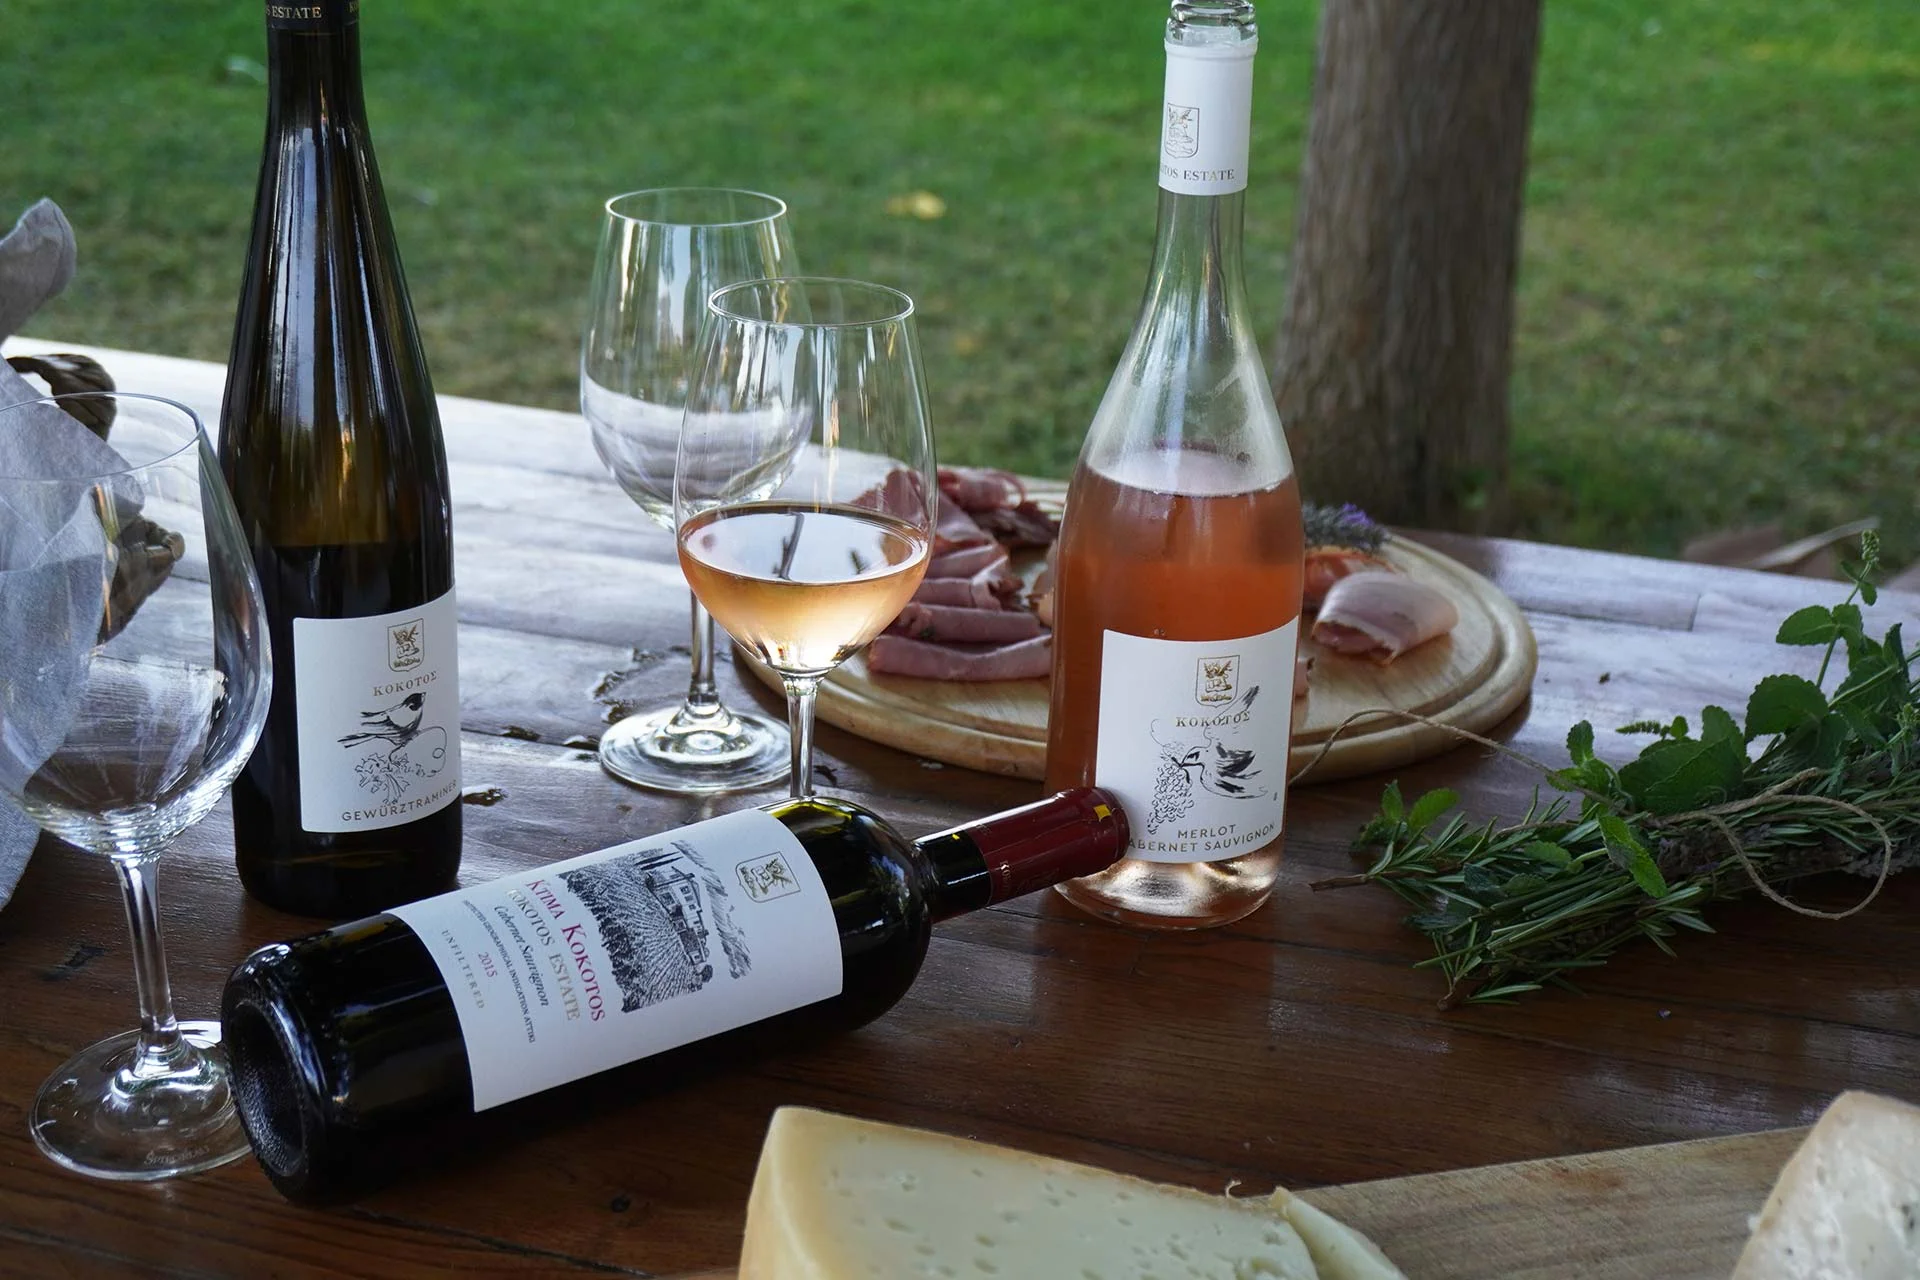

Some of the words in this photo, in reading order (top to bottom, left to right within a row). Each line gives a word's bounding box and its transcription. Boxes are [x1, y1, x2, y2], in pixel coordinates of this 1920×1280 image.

[272, 5, 322, 19] ESTATE
[1183, 168, 1235, 181] ESTATE
[373, 670, 437, 697] ΚΟΚΟΤΟΣ
[341, 779, 457, 822] GEWÜRZTRAMINER
[1128, 839, 1199, 853] ABERNET
[1204, 822, 1275, 851] SAUVIGNON
[1177, 823, 1237, 839] MERLOT
[441, 929, 485, 1009] UNFILTERED
[478, 952, 498, 978] 2015
[493, 905, 526, 944] Cabernet
[520, 944, 549, 1007] Sauvignon
[525, 879, 567, 920] KTIMA
[560, 923, 606, 1022] KOKOTOS
[508, 969, 529, 1016] INDICATION
[549, 952, 581, 1021] ESTATE
